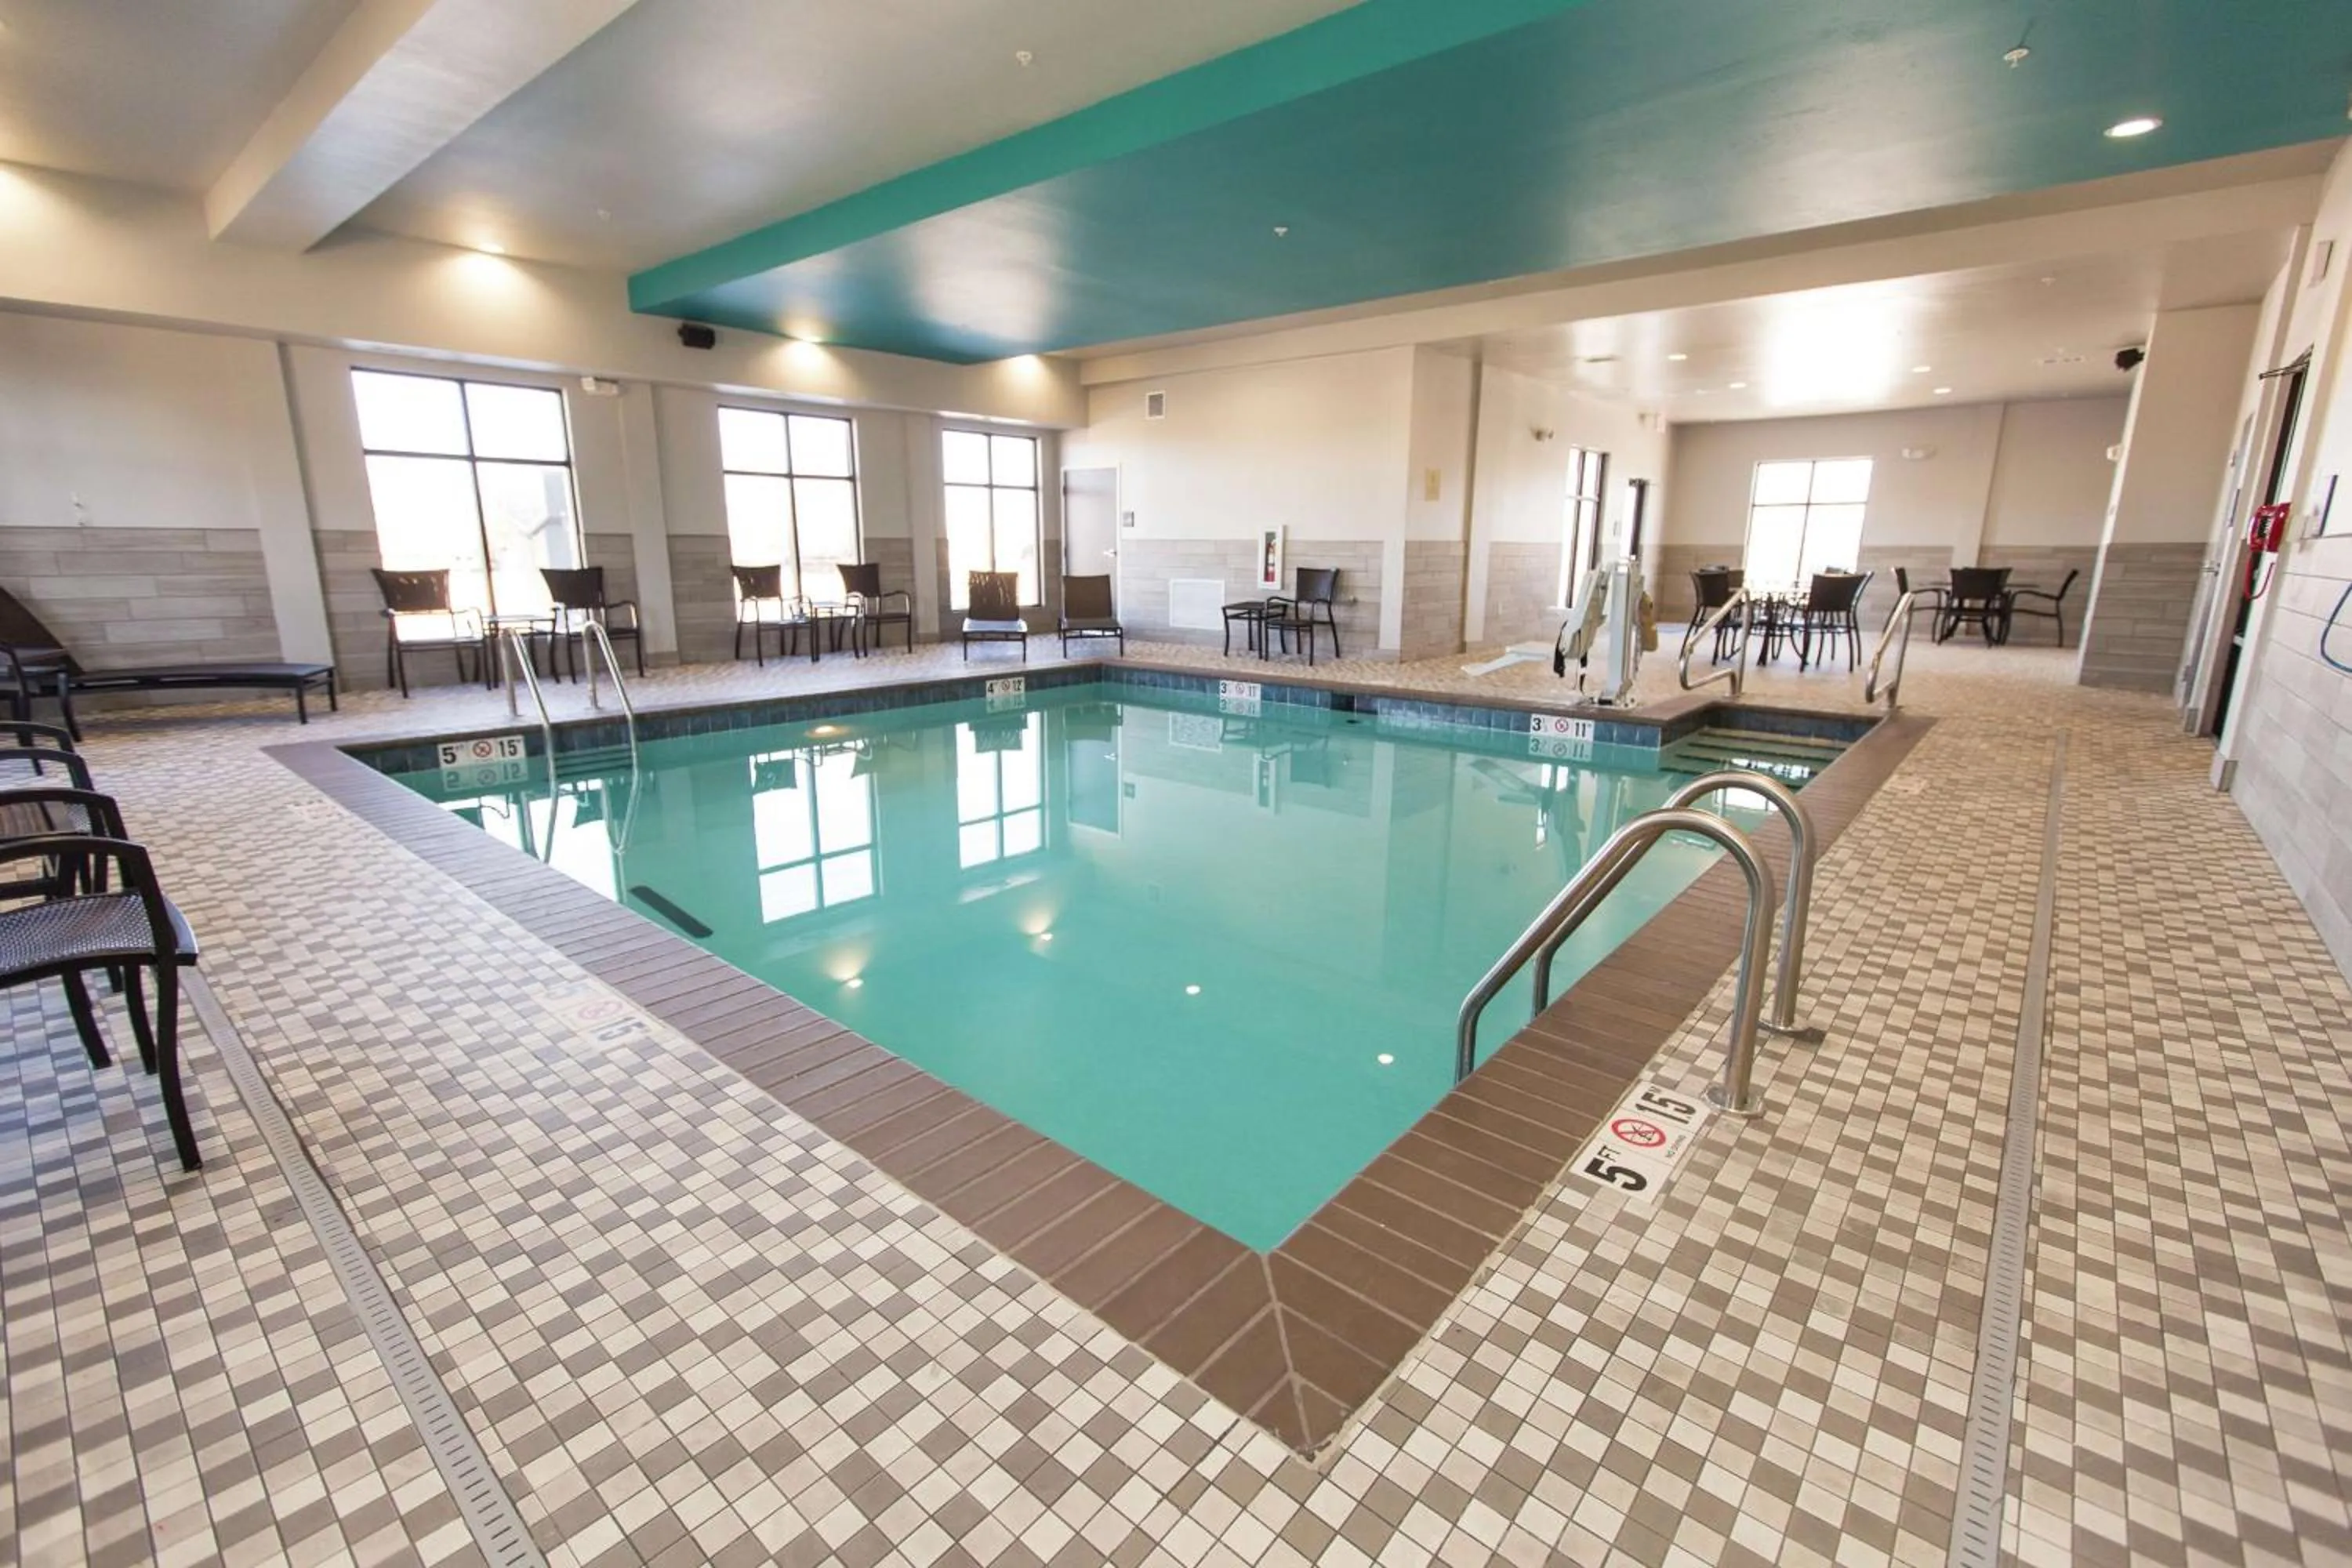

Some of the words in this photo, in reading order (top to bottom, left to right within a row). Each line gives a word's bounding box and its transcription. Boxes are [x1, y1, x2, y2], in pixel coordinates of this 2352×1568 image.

[1221, 682, 1227, 694] 3
[1532, 717, 1541, 731] 3
[442, 746, 456, 764] 5
[1597, 1145, 1621, 1163] FT
[1584, 1157, 1647, 1191] 5
